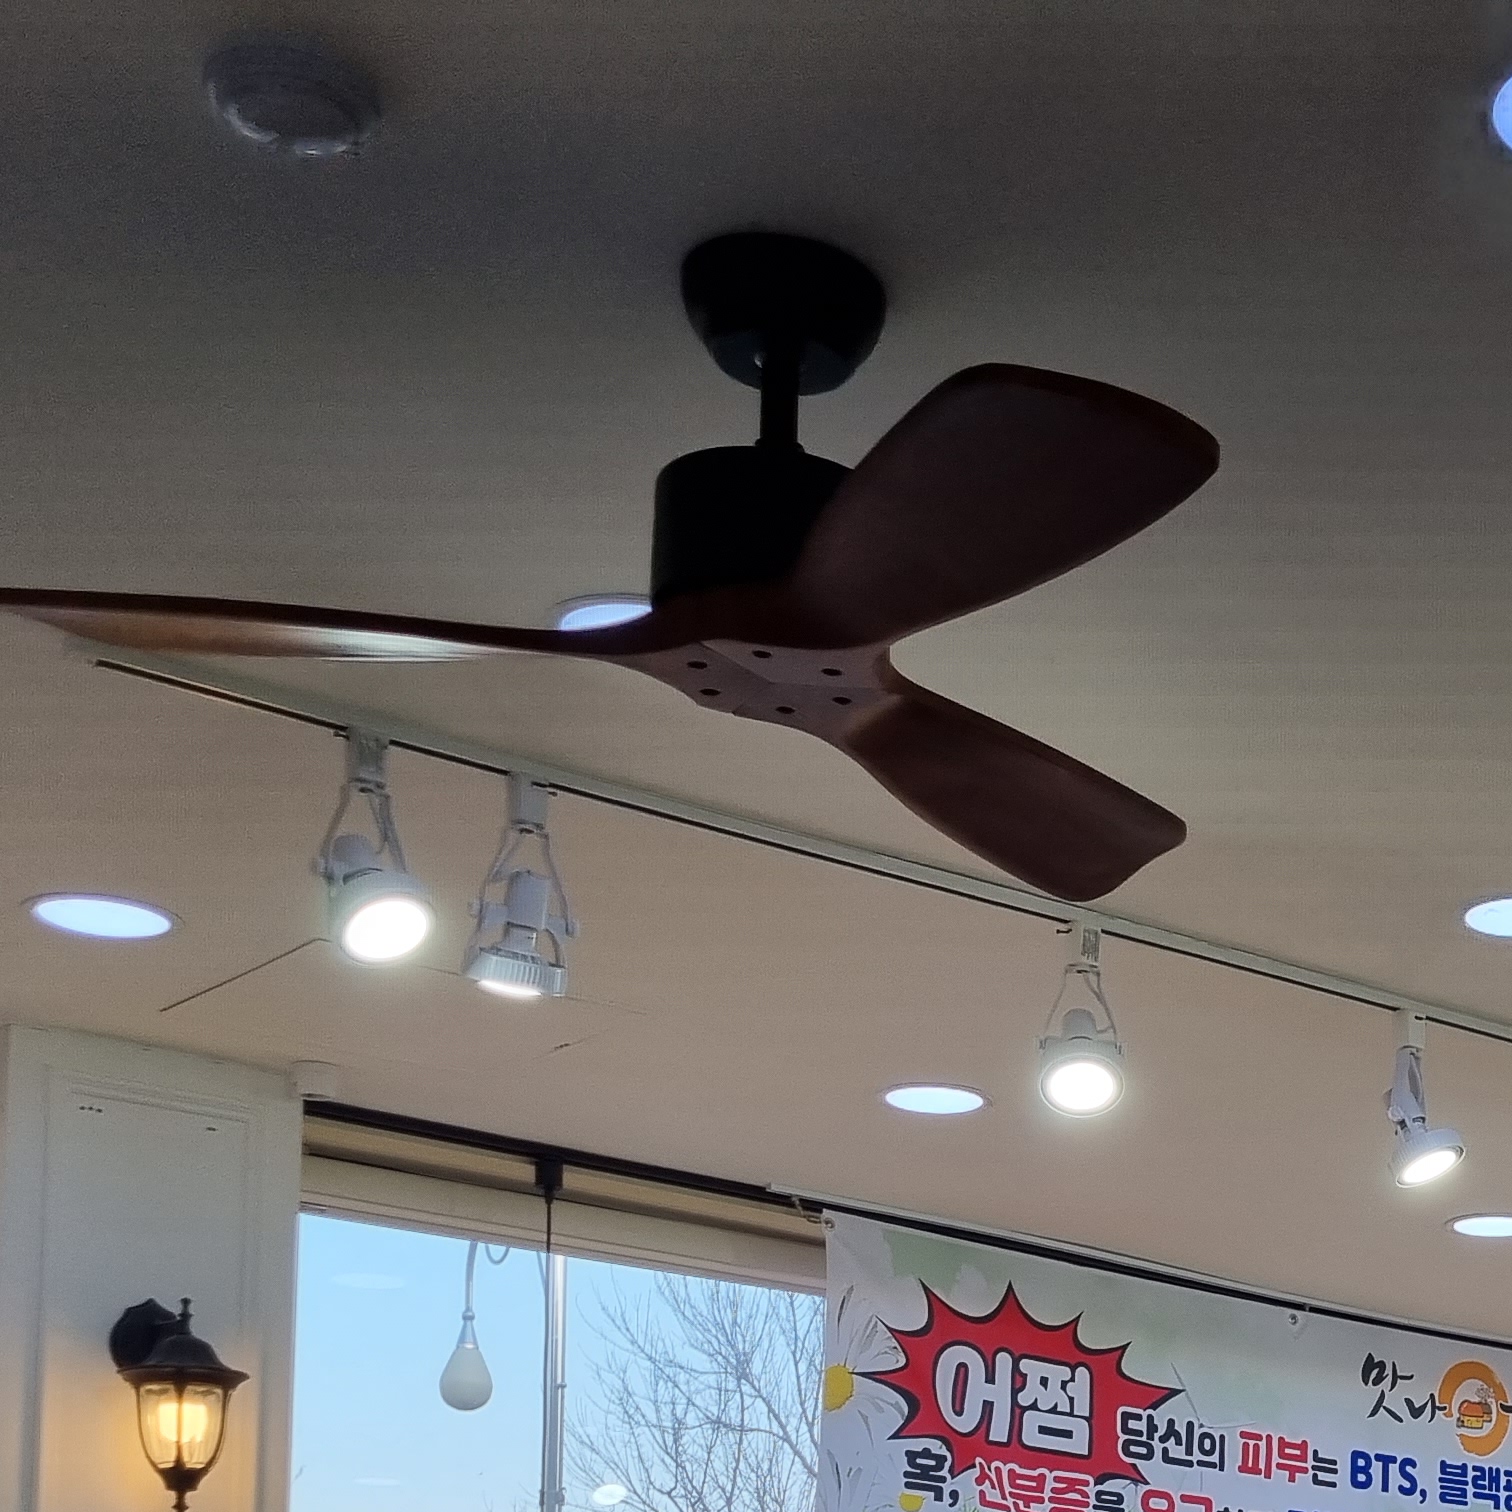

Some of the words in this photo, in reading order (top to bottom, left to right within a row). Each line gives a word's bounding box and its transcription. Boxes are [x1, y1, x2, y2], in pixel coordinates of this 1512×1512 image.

[935, 1344, 1093, 1457] 어쩜
[903, 1447, 960, 1508] 혹,
[1120, 1411, 1226, 1472] 당신의
[1237, 1430, 1338, 1489] 피부는
[1350, 1450, 1427, 1504] BTS,
